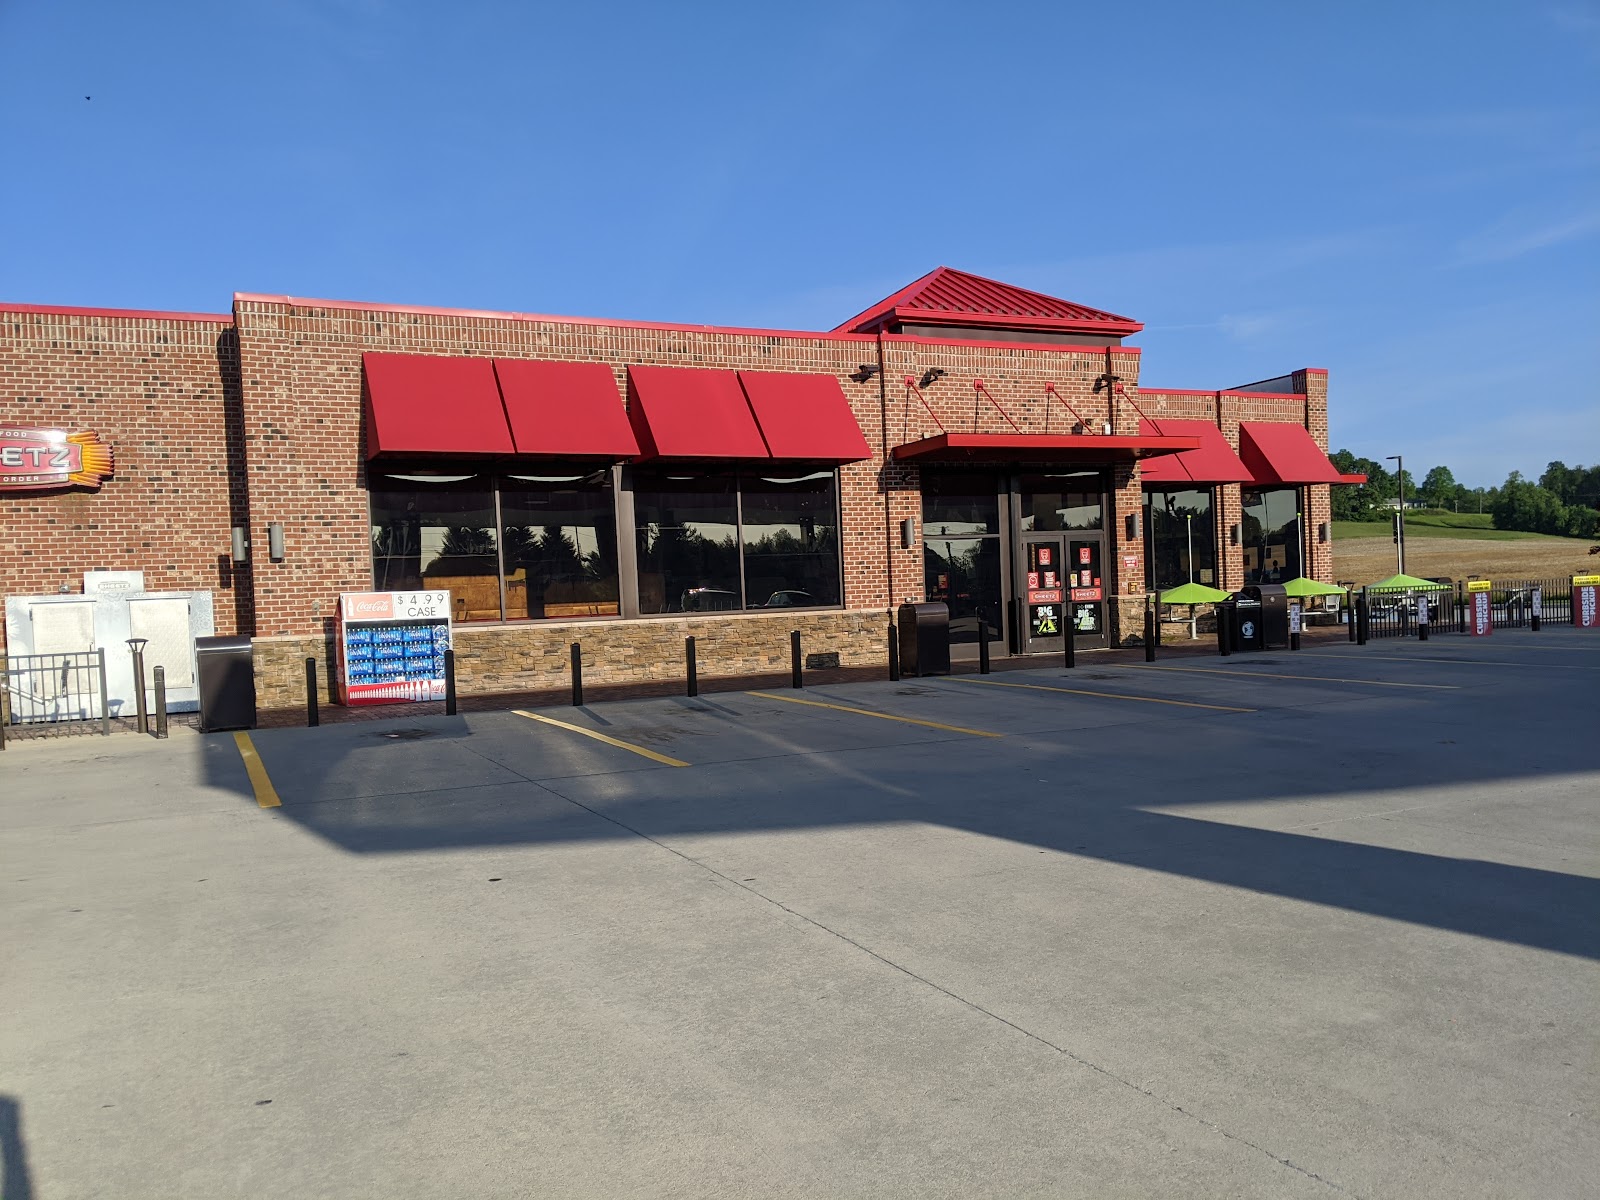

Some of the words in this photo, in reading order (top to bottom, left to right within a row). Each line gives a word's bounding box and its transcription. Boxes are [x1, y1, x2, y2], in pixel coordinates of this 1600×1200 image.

[0, 447, 71, 467] ETZ
[407, 607, 437, 617] CASE
[1038, 606, 1053, 617] BIG
[1077, 609, 1089, 618] BIG
[1475, 592, 1484, 635] CURBSIDE
[1581, 586, 1590, 626] CURBSIDE
